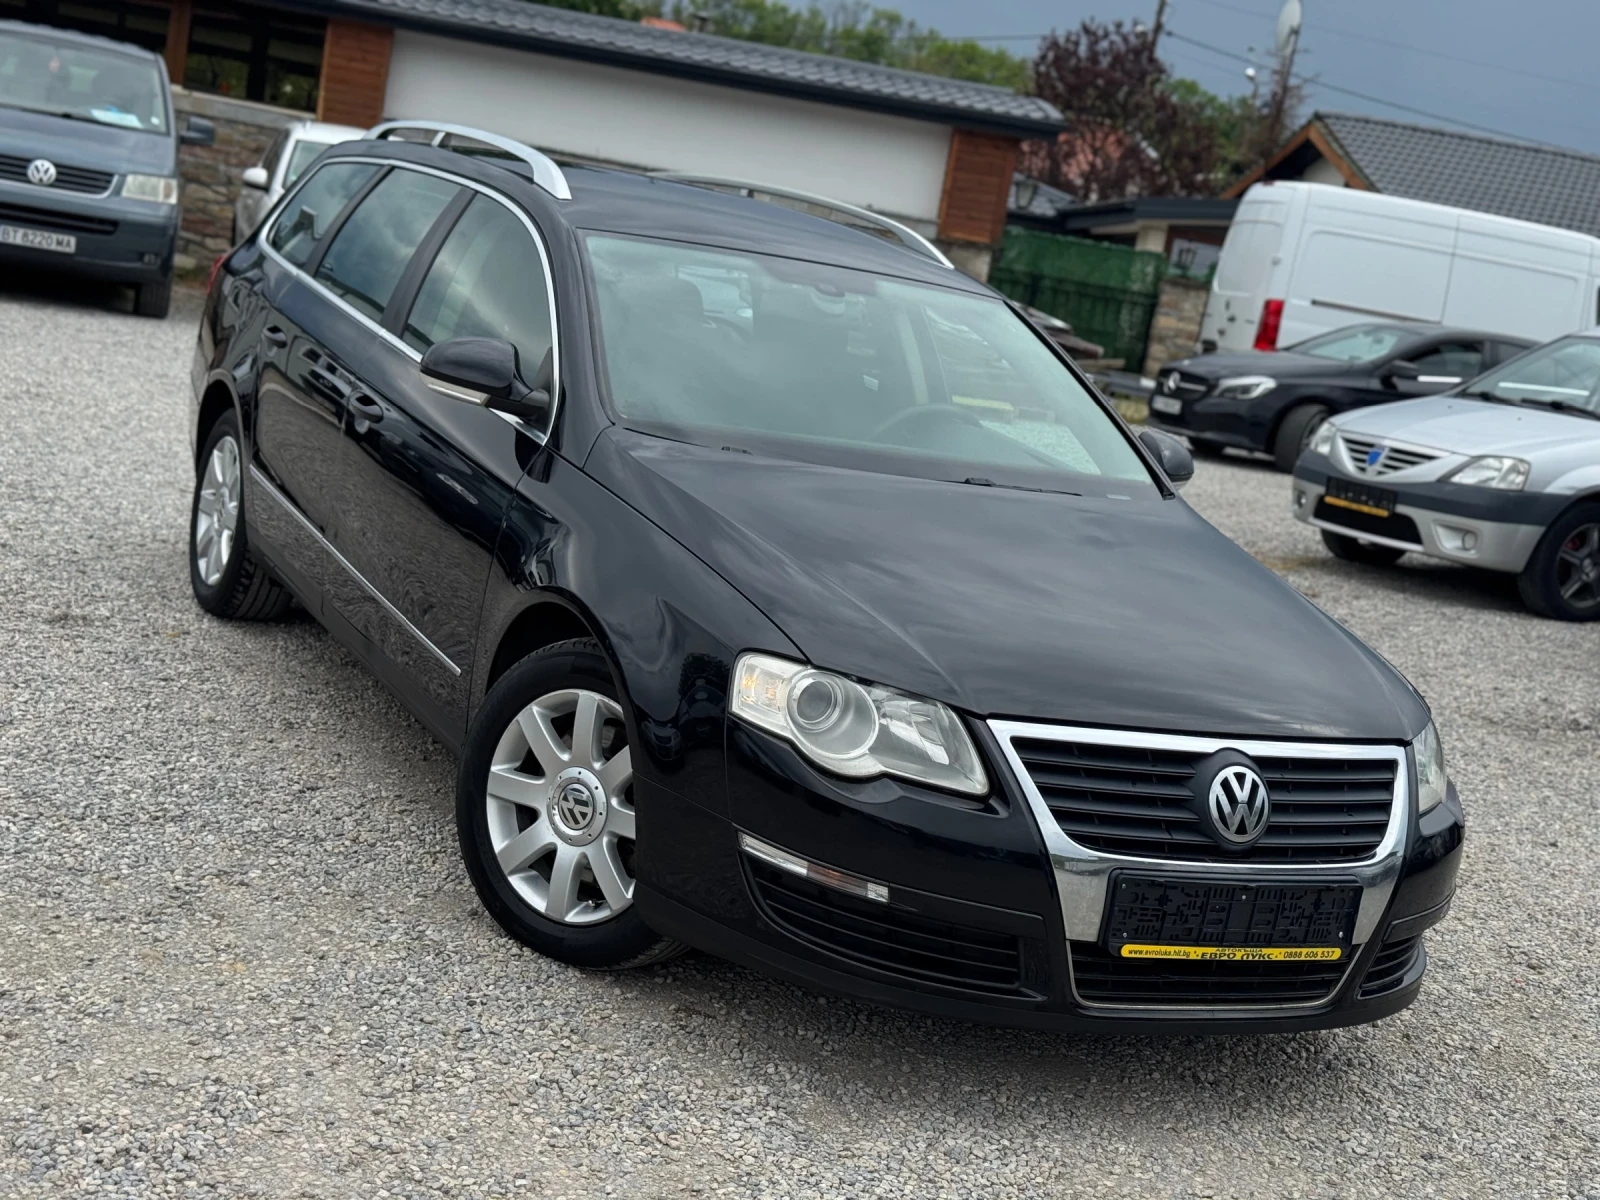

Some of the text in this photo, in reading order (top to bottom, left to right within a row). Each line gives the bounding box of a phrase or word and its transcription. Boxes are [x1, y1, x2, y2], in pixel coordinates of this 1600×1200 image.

[1208, 765, 1269, 843] VW
[1200, 952, 1275, 961] ЕВРО ЛУКС
[1283, 950, 1336, 959] 0888 606 537
